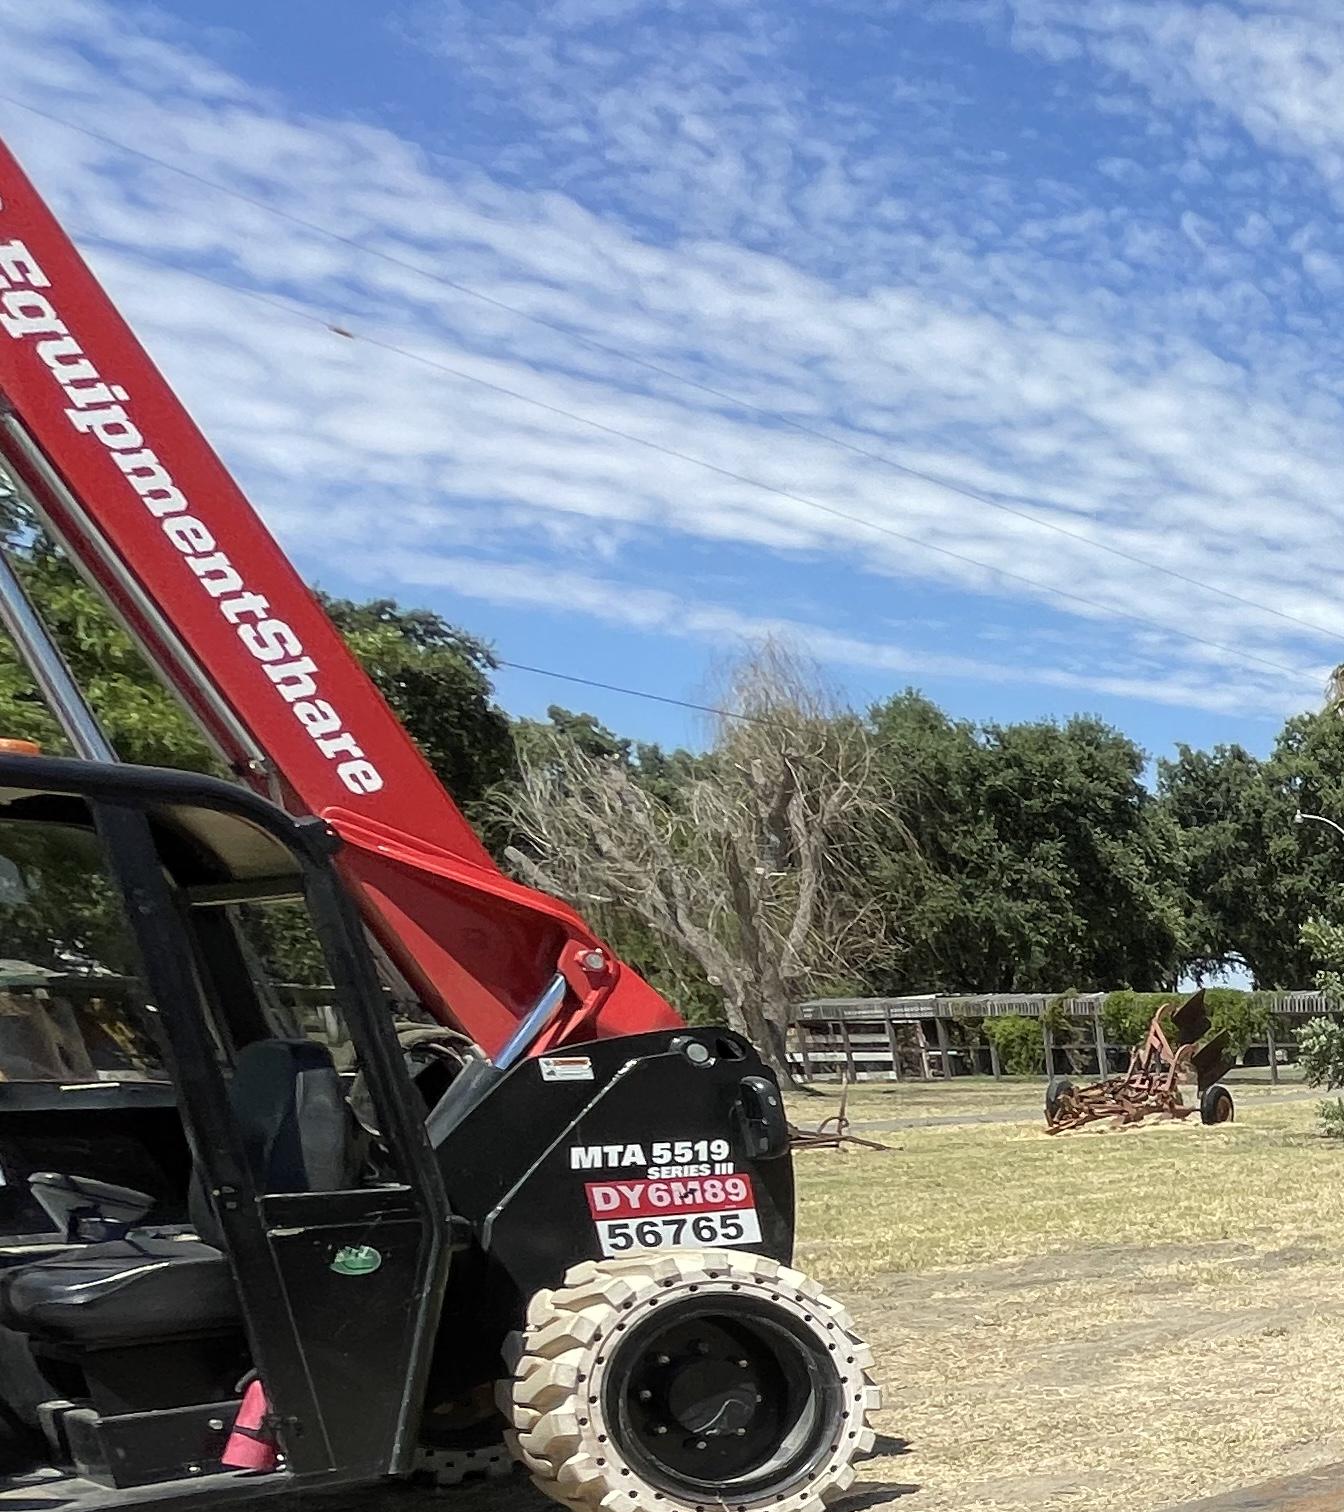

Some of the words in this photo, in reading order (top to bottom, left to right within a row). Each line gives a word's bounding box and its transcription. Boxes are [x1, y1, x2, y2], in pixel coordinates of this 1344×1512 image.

[0, 240, 383, 796] EquipmentShare
[570, 1144, 647, 1170] MTA
[652, 1139, 730, 1164] 5519
[647, 1163, 711, 1180] SERIES
[715, 1162, 734, 1175] III
[592, 1177, 748, 1212] DY6M89
[607, 1214, 744, 1250] 56765
